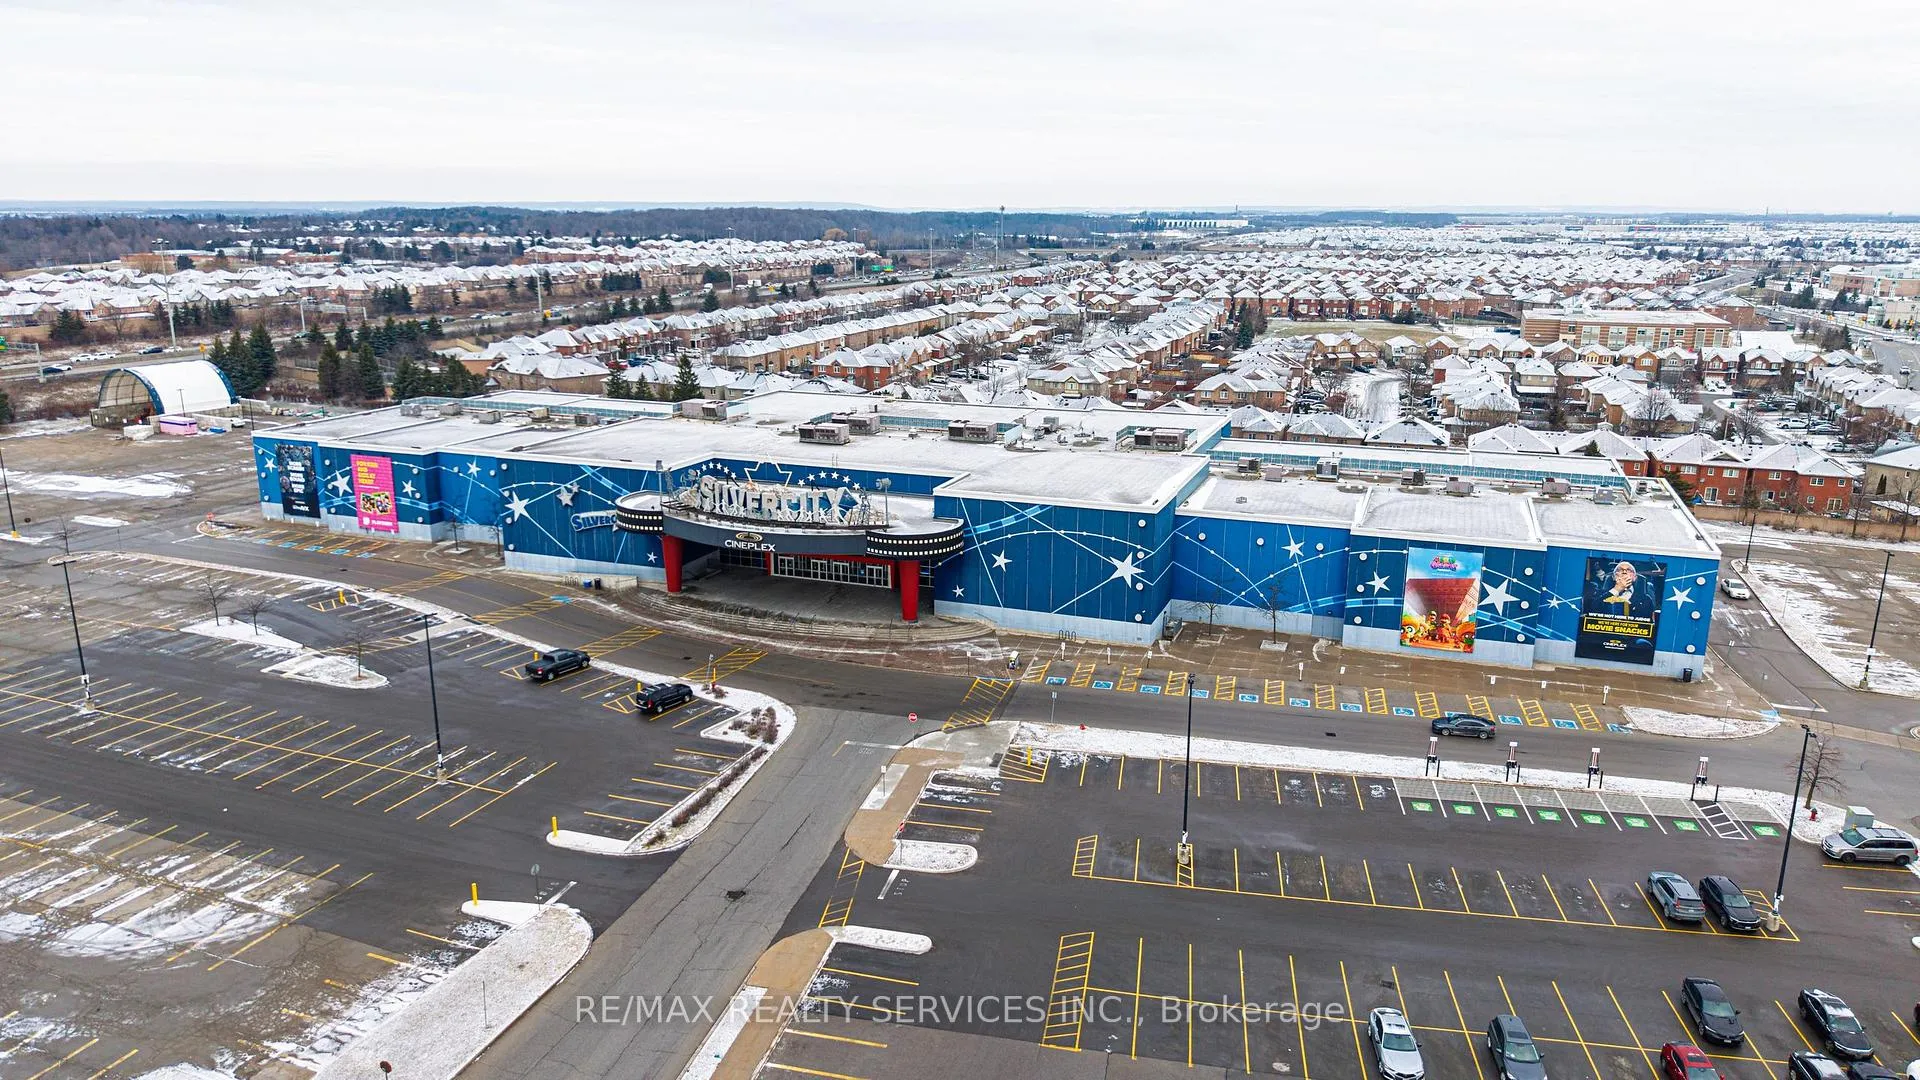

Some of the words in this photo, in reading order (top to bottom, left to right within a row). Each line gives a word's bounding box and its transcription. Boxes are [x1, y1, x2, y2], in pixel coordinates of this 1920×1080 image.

[700, 475, 850, 525] SILVERCITY
[724, 540, 776, 552] CINEPLEX
[1587, 624, 1613, 632] MOVIE
[1614, 626, 1648, 635] SNACKS
